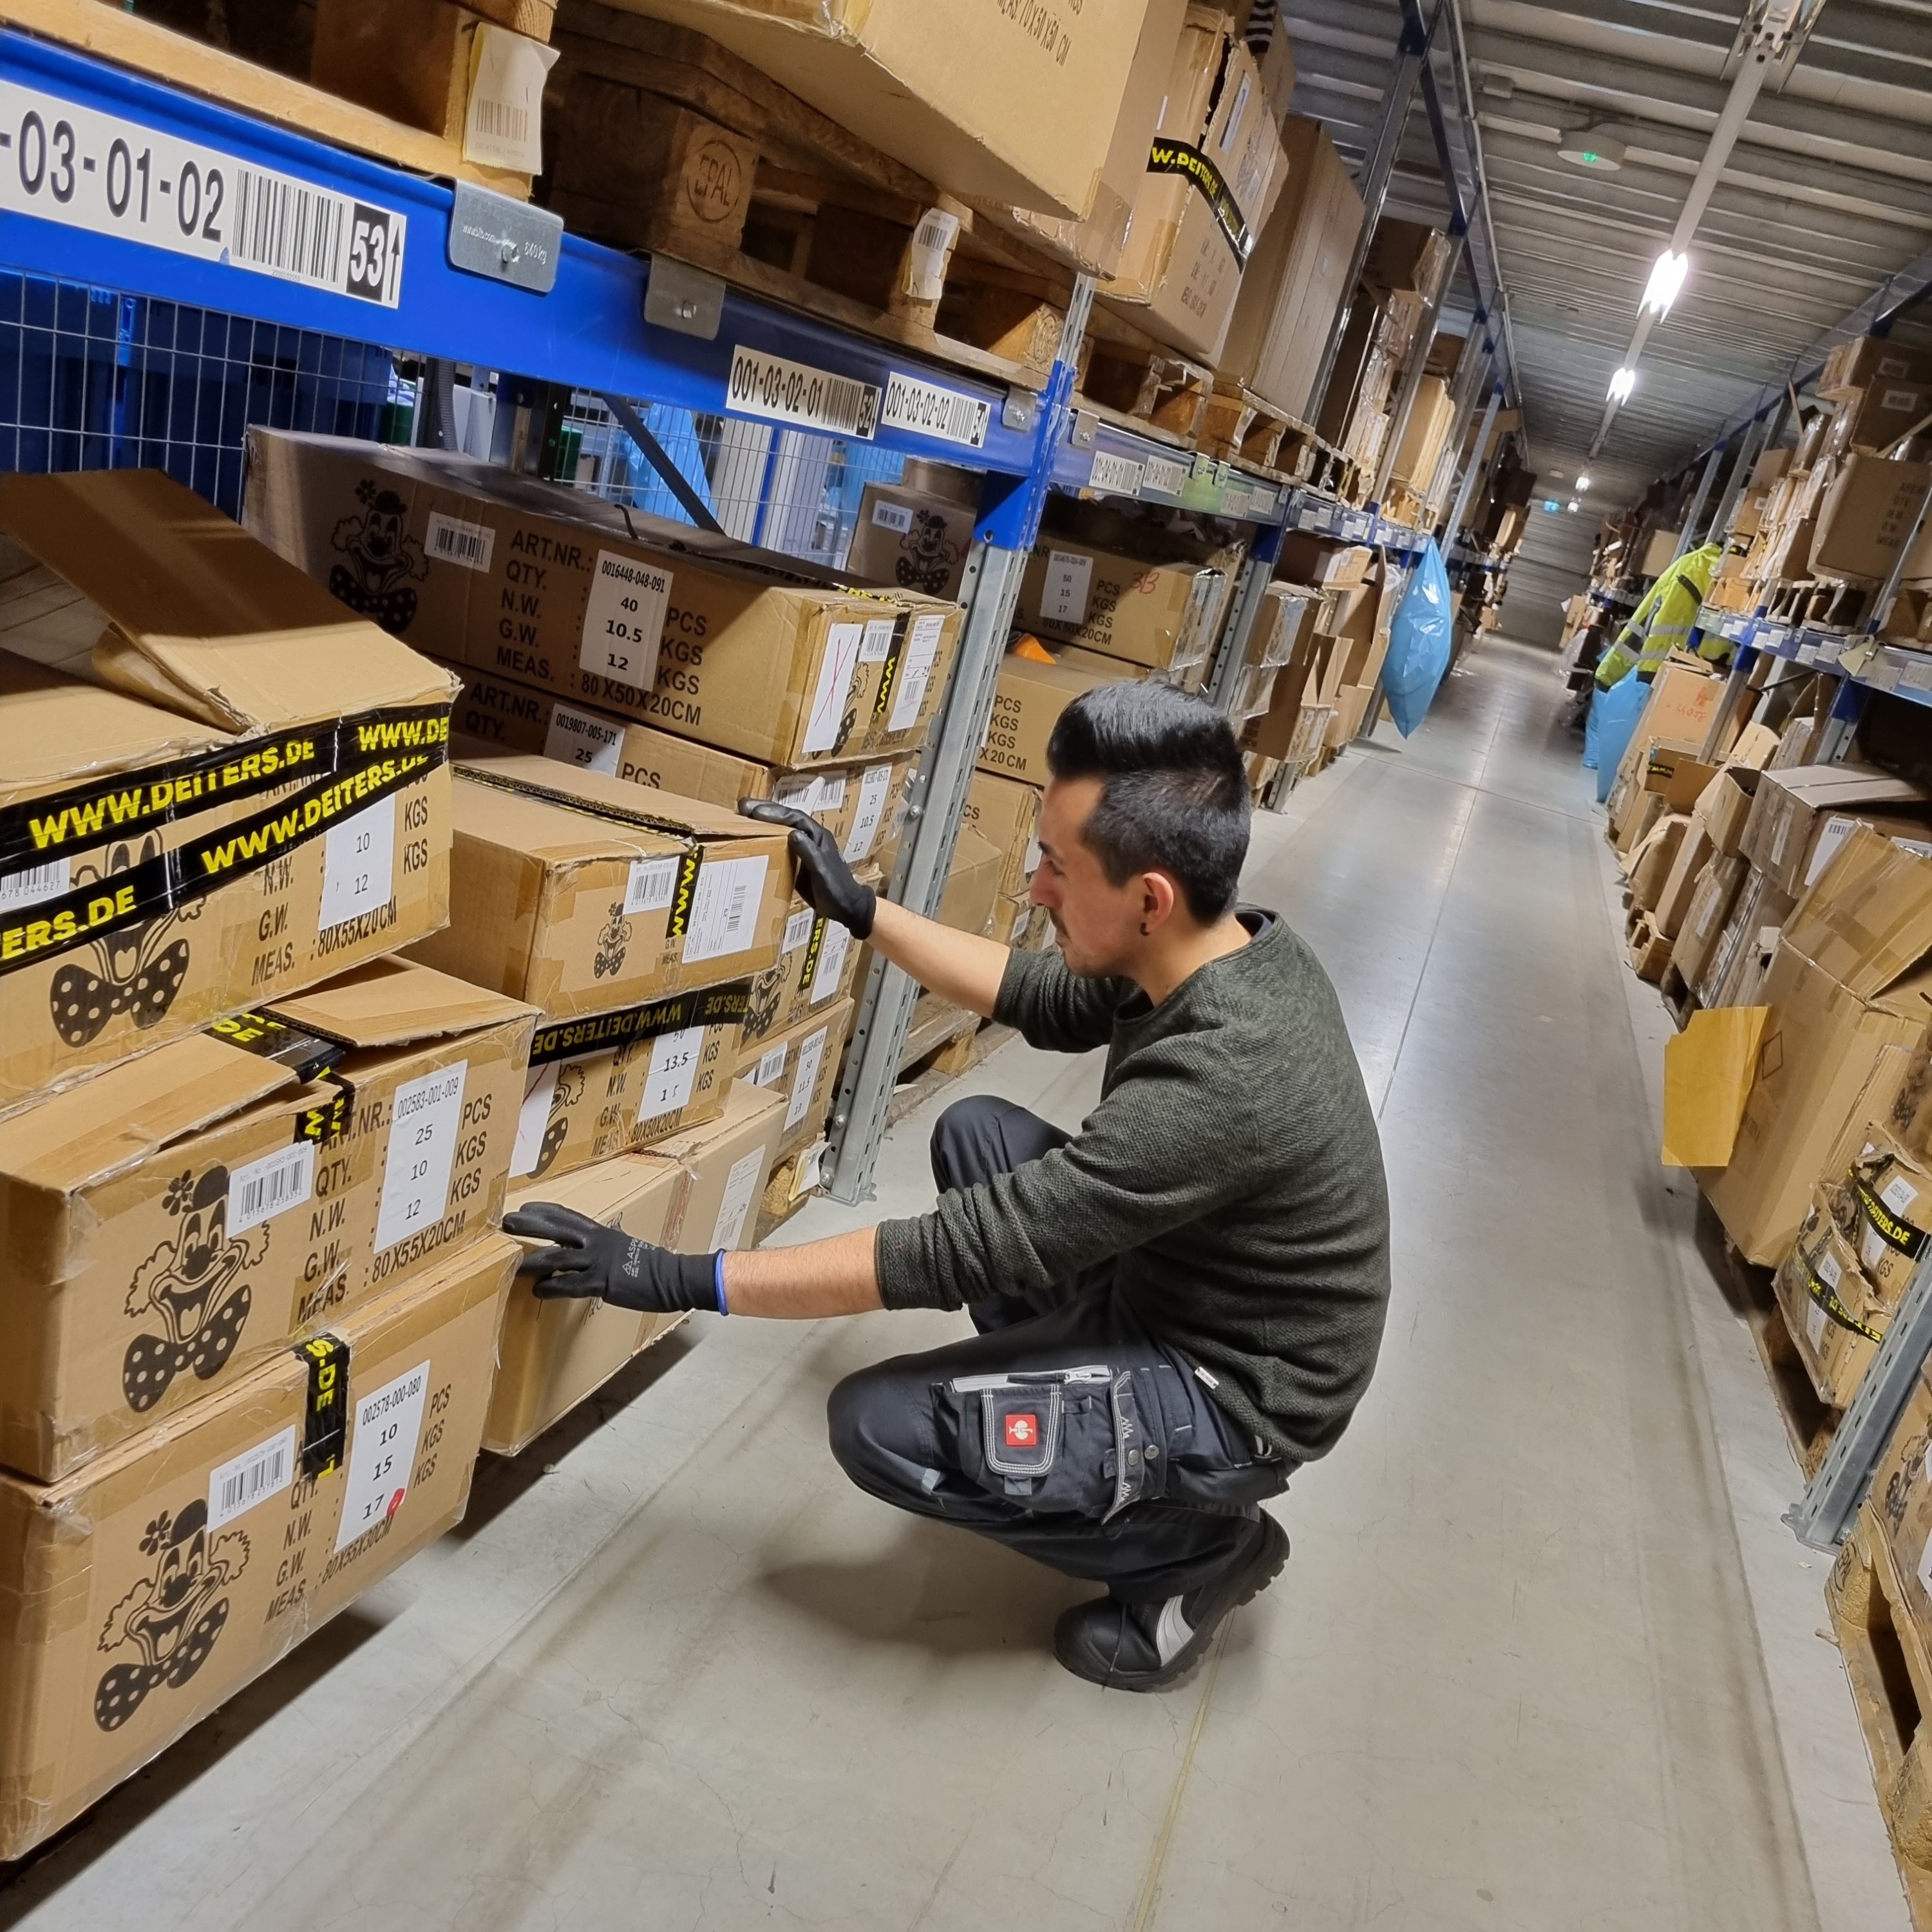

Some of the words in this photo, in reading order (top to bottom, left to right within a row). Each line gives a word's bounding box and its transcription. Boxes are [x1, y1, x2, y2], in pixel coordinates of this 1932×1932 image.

[694, 154, 733, 207] EPAL
[350, 220, 384, 287] 53
[732, 355, 824, 417] 001-03-02-01
[886, 381, 950, 430] 001-03-02-02
[858, 395, 874, 428] 52
[506, 560, 546, 591] QTY.
[620, 597, 638, 612] 40
[665, 607, 707, 636] PCS
[601, 560, 666, 593] 0016448-048-091
[1097, 580, 1121, 596] PCS
[1060, 589, 1070, 598] 15
[1092, 596, 1117, 612] KGS
[1088, 612, 1113, 629] KGS
[501, 588, 541, 619] N.W.
[605, 620, 643, 643] 10.5
[659, 635, 703, 666] KGS
[497, 646, 554, 682] MEAS.
[499, 618, 540, 648] G.W.
[607, 654, 629, 670] 12
[656, 665, 700, 696] KGS
[990, 712, 1019, 731] KGS
[994, 695, 1022, 713] PCS
[466, 710, 505, 742] QTY.
[575, 748, 593, 764] 25
[621, 762, 661, 790] PCS
[556, 713, 616, 746] 0019807-005-171
[987, 730, 1016, 749] KGS
[28, 739, 315, 849] WWW.DEITERS.DE
[404, 796, 428, 832] KGS
[869, 794, 877, 805] 25
[963, 804, 980, 820] CS
[860, 815, 875, 829] 10.5
[263, 856, 294, 896] N.W.
[356, 832, 370, 853] 10
[404, 838, 428, 874] KGS
[853, 841, 863, 853] 12
[23, 880, 61, 896] 044627
[259, 902, 288, 942] G.W.
[354, 874, 368, 895] 12
[1, 884, 137, 961] ERS.DE
[251, 942, 295, 986] MEAS.
[663, 1052, 689, 1072] 13.5
[703, 1040, 720, 1065] KGS
[397, 1077, 459, 1119] 002583-001-009
[462, 1094, 492, 1130] PCS
[606, 1072, 627, 1098] N.W.
[696, 1069, 714, 1094] KGS
[316, 1155, 352, 1198] QTY.
[415, 1124, 433, 1145] 25
[455, 1131, 488, 1168] KGS
[309, 1198, 346, 1242] N.W.
[410, 1160, 428, 1180] 10
[450, 1168, 482, 1206] KGS
[304, 1238, 341, 1282] G.W.
[405, 1199, 421, 1220] 12
[363, 1376, 421, 1426] 002578-000-080
[429, 1383, 451, 1419] PCS
[379, 1423, 397, 1446] 10
[421, 1419, 444, 1455] KGS
[283, 1510, 312, 1551] N.W.
[372, 1455, 393, 1482] 15
[413, 1453, 437, 1489] KGS
[276, 1548, 306, 1587] G.W.
[362, 1493, 384, 1520] 17
[264, 1578, 307, 1625] MEAS.
